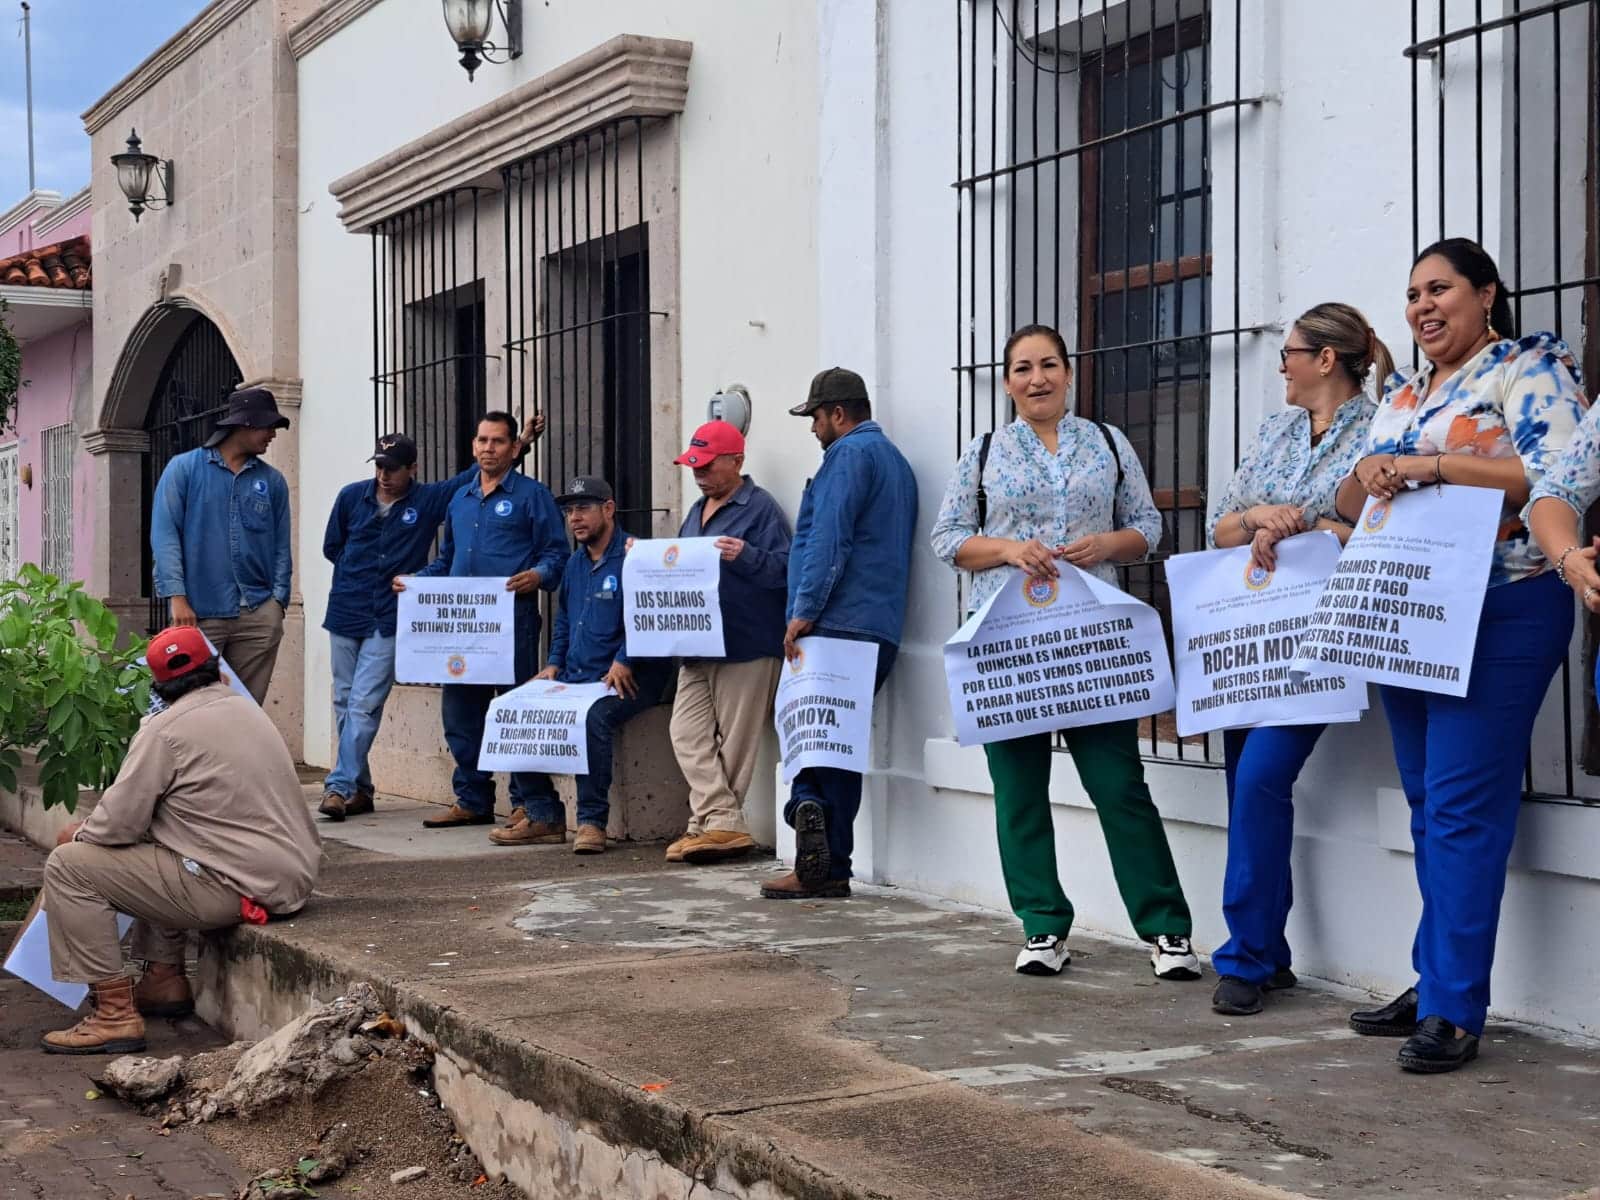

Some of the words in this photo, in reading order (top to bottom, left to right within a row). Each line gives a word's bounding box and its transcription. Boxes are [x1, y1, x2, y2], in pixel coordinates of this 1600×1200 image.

[1336, 560, 1377, 574] ARAMOS
[1379, 560, 1431, 580] PORQUE
[1331, 577, 1354, 591] FALTA
[1356, 578, 1372, 592] DE
[1373, 578, 1408, 596] PAGO
[418, 593, 454, 604] SUELDO
[457, 593, 497, 605] NUESTRO
[635, 591, 654, 608] LOS
[656, 591, 705, 608] SALARIOS
[1333, 595, 1358, 609] SOLO
[1360, 596, 1368, 610] A
[1372, 598, 1447, 622] NOSOTROS,
[437, 608, 448, 618] DE
[451, 608, 476, 619] VIVEN
[634, 614, 654, 631] SON
[657, 614, 712, 631] SAGRADOS
[1334, 612, 1388, 632] TAMBIÉN
[1390, 619, 1399, 634] A
[411, 621, 454, 632] FAMILIAS
[456, 622, 501, 633] NUESTRAS
[1233, 624, 1266, 640] SEÑOR
[1268, 615, 1308, 634] GOBERN
[968, 646, 980, 658] LA
[982, 640, 1013, 656] FALTA
[1015, 637, 1029, 650] DE
[1032, 630, 1061, 647] PAGO
[1064, 628, 1078, 640] DE
[1081, 617, 1133, 638] NUESTRA
[1347, 632, 1411, 655] FAMILIAS.
[976, 653, 1034, 675] QUINCENA
[1036, 650, 1050, 663] ES
[1051, 636, 1130, 660] INACEPTABLE;
[1203, 642, 1259, 675] ROCHA
[1264, 634, 1304, 663] MOY
[1320, 647, 1385, 670] SOLUCIÓN
[1388, 657, 1460, 682] INMEDIATA
[962, 680, 985, 695] POR
[1017, 670, 1041, 685] NOS
[1043, 662, 1083, 680] VEMOS
[1085, 650, 1152, 673] OBLIGADOS
[1212, 671, 1260, 691] NUESTROS
[966, 700, 974, 712] A
[976, 693, 1014, 711] PARAR
[1016, 683, 1074, 704] NUESTRAS
[1077, 669, 1154, 694] ACTIVIDADES
[1227, 684, 1282, 704] NECESITAN
[521, 710, 577, 725] PRESIDENTA
[797, 708, 840, 728] MOYA,
[976, 711, 1014, 728] HASTA
[1016, 707, 1038, 723] QUE
[1040, 704, 1055, 717] SE
[1056, 696, 1102, 715] REALICE
[1104, 694, 1117, 707] EL
[1118, 688, 1150, 704] PAGO
[500, 728, 536, 740] EXIGIMOS
[538, 728, 546, 740] EL
[547, 728, 568, 741] PAGO
[487, 742, 498, 754] DE
[499, 743, 537, 755] NUESTROS
[804, 741, 853, 755] ALIMENTOS
